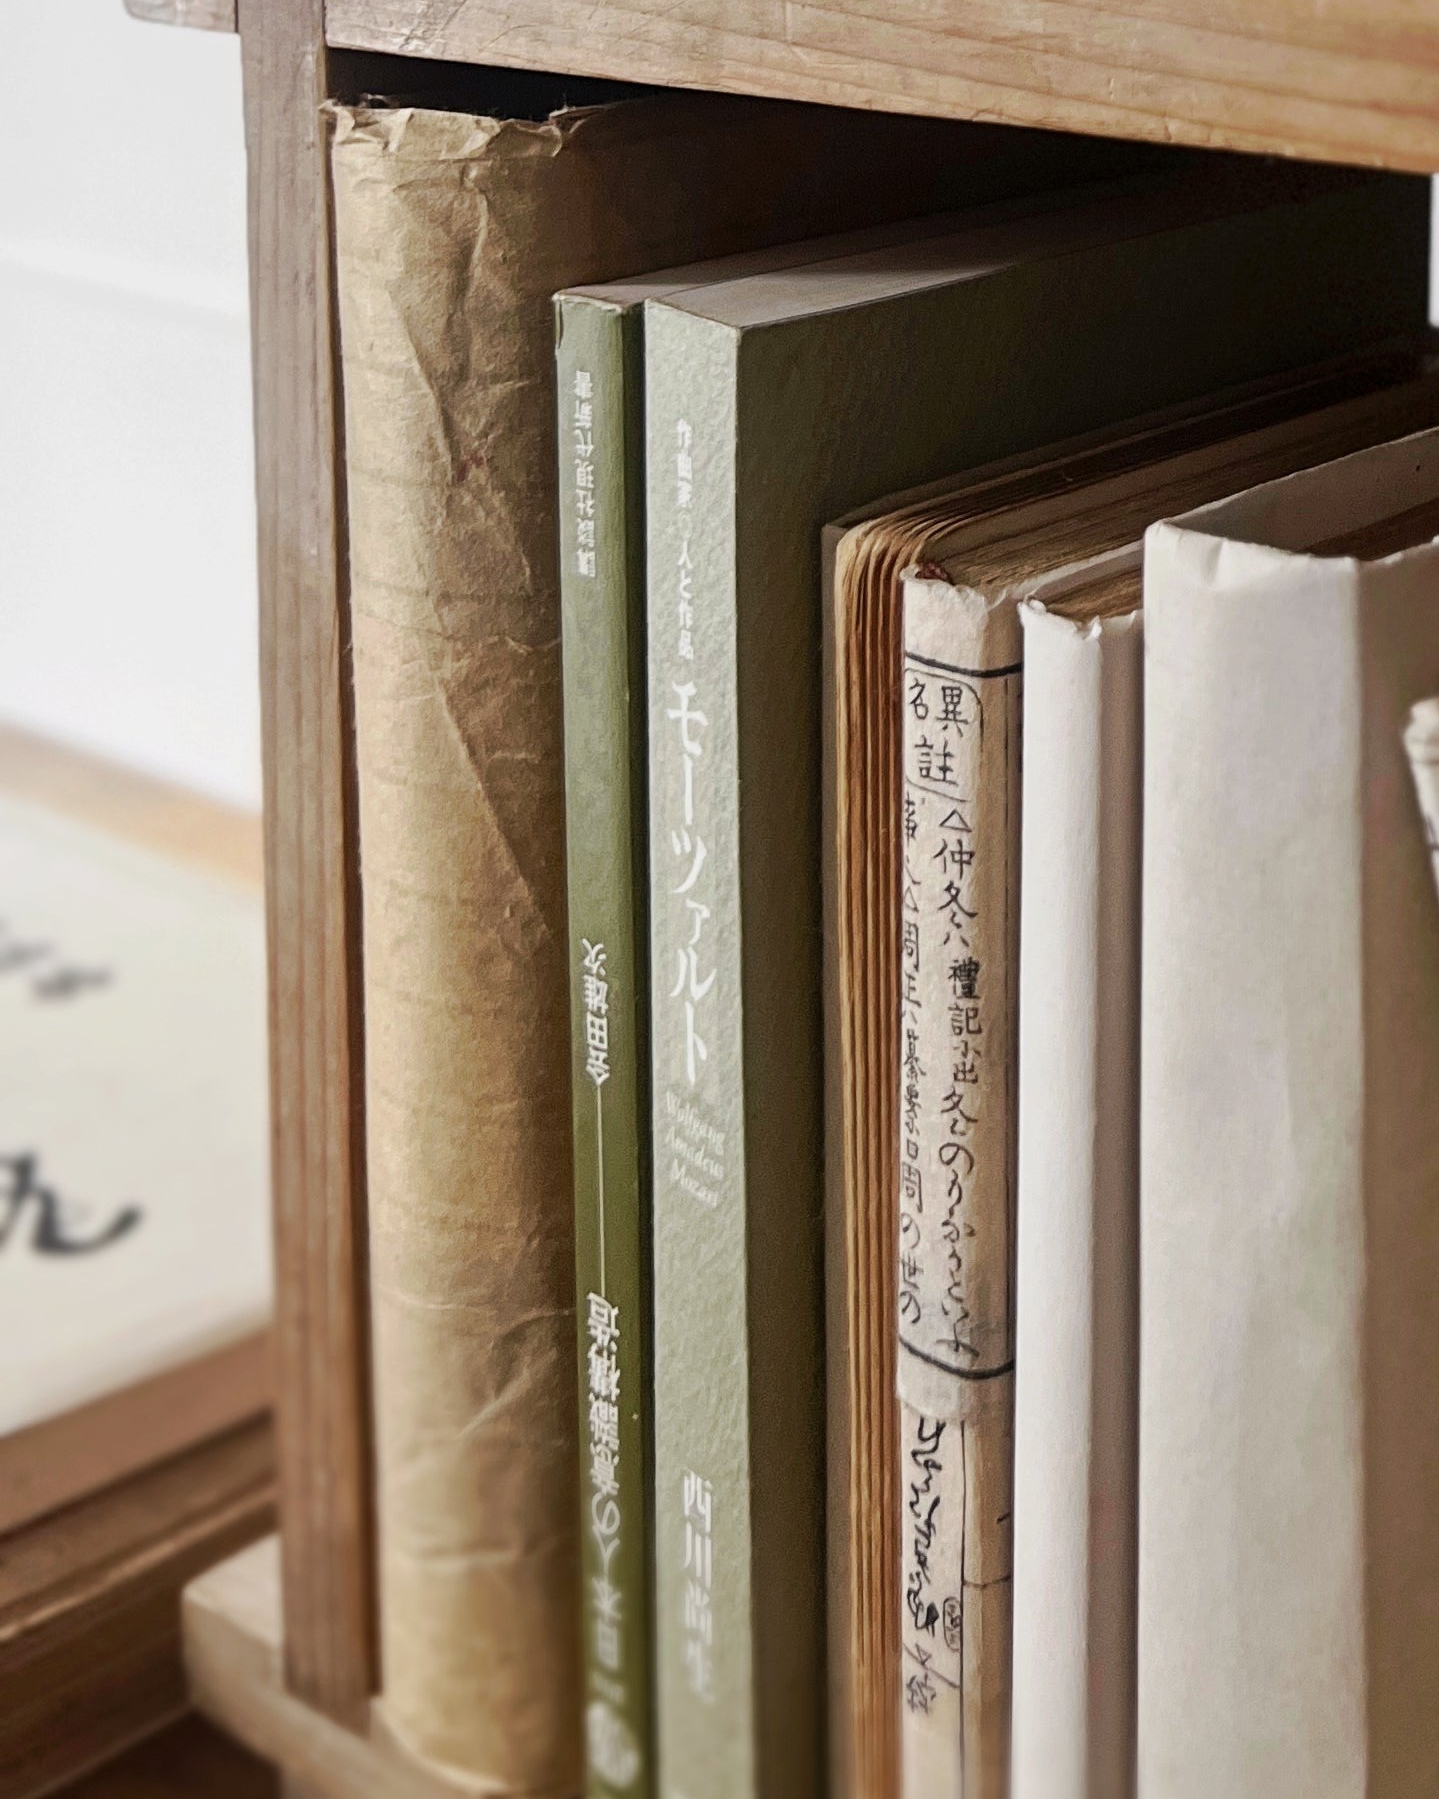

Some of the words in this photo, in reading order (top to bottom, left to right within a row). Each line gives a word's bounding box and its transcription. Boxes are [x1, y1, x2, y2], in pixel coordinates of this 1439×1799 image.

[666, 680, 717, 1084] モーツァルト
[665, 1089, 725, 1156] Wolfgang
[665, 1125, 724, 1180] Amadeus
[670, 1158, 719, 1208] Mozart
